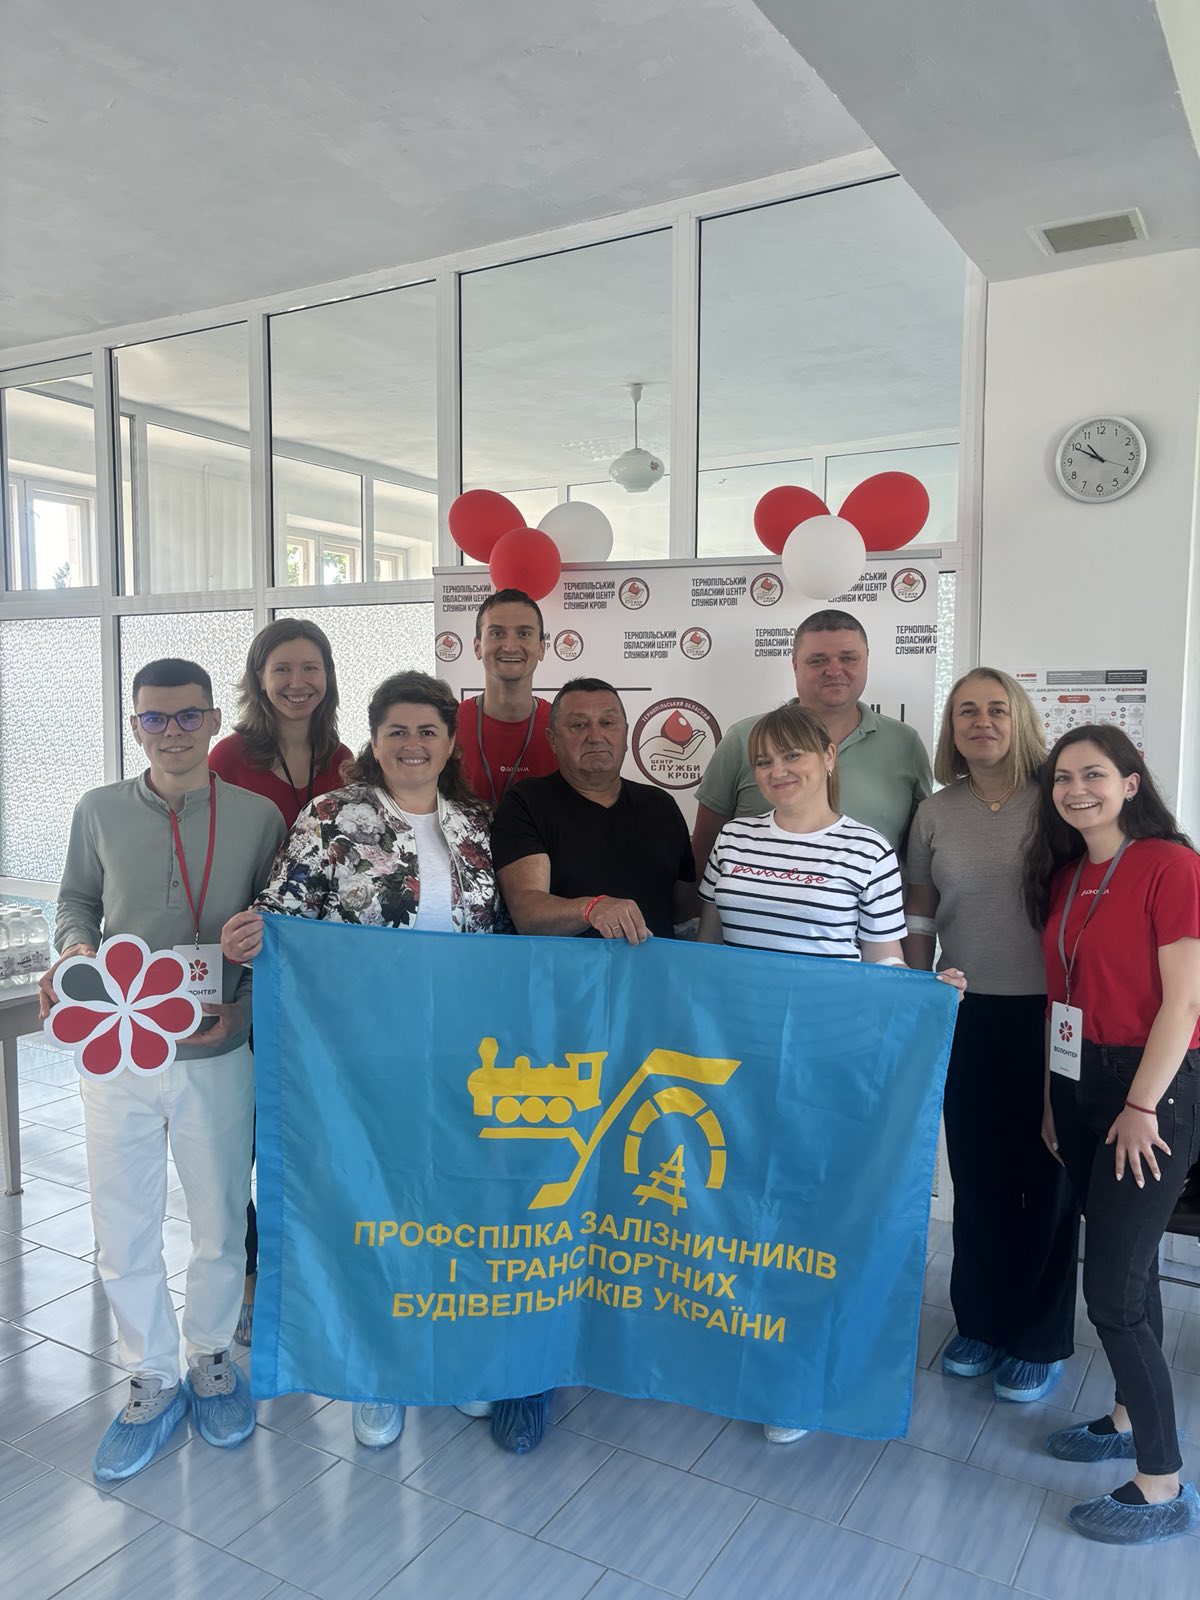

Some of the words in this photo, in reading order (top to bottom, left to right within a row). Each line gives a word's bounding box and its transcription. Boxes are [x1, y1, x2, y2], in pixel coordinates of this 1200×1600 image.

[1097, 426, 1105, 434] 12
[1125, 437, 1131, 446] 2
[1072, 443, 1081, 451] 10
[1129, 452, 1135, 460] 3
[1067, 458, 1072, 466] 9
[1123, 466, 1129, 474] 4
[1071, 471, 1076, 479] 8
[1082, 481, 1087, 489] 7
[1112, 478, 1118, 486] 5
[1096, 484, 1103, 492] 6
[564, 580, 615, 590] ТЕРНОПІЛЬСЬКИЙ
[692, 576, 746, 586] ТЕРНОПІЛЬСЬКИЙ
[865, 583, 887, 591] ЦЕНТР
[564, 591, 595, 600] ОБЛАСНИЙ
[596, 591, 615, 599] ЦЕНТР
[692, 587, 724, 596] ОБЛАСНИЙ
[726, 587, 746, 596] ЦЕНТР
[590, 601, 607, 609] КРОВІ
[692, 598, 718, 606] СЛУЖБИ
[719, 598, 737, 606] КРОВІ
[896, 625, 937, 634] ТЕРНОПІЛЬС
[624, 629, 676, 639] ТЕРНОПІЛЬСЬКИЙ
[755, 637, 789, 647] ОБЛАСНИЙ
[896, 634, 932, 644] ОБЛАСНИЙ
[624, 640, 655, 649] ОБЛАСНИЙ
[657, 641, 676, 649] ЦЕНТР
[650, 650, 668, 658] КРОВІ
[755, 649, 782, 657] СЛУЖБИ
[896, 646, 924, 654] СЛУЖБИ
[728, 865, 829, 884] paradise
[1054, 1046, 1077, 1058] ВОЛОНТЕР
[354, 1220, 573, 1248] ПРОФСПІЛКА
[580, 1212, 837, 1280] ЗАЛІЗНИЧНИКІВ
[450, 1258, 457, 1282] І
[486, 1246, 737, 1298] ТРАНСПОРТНИХ
[392, 1278, 643, 1321] БУДІВЕЛЬНИКІВ
[654, 1287, 786, 1342] УКРАЇНИ
